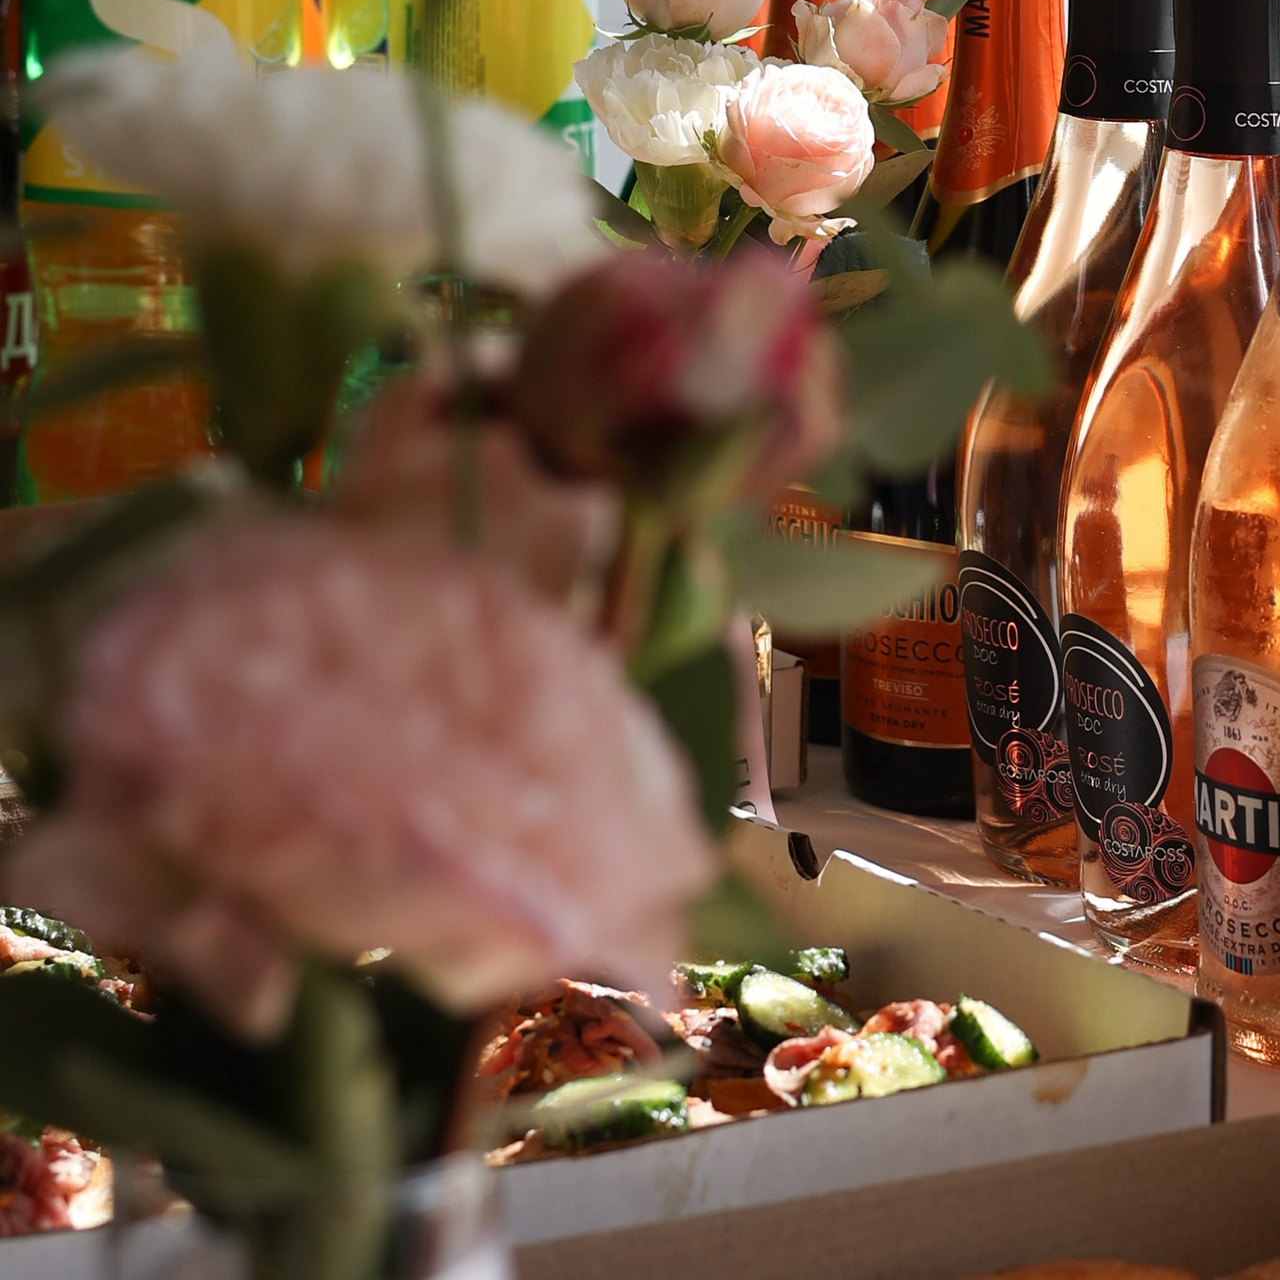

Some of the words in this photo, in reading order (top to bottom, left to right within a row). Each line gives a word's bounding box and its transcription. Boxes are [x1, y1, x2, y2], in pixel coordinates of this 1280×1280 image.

[1123, 78, 1174, 94] COSTA
[963, 607, 1019, 651] PROSECCO
[973, 644, 998, 665] DOC
[871, 677, 924, 696] TREVISO
[974, 679, 1020, 704] ROSÉ
[1065, 670, 1125, 721] PROSECCO
[903, 719, 926, 731] DRY
[999, 704, 1021, 728] dry
[1077, 712, 1103, 735] DOC
[1223, 724, 1242, 741] 1863
[1078, 745, 1126, 777] ROSÉ
[1104, 776, 1127, 803] dry
[1224, 894, 1252, 911] D.O.C.
